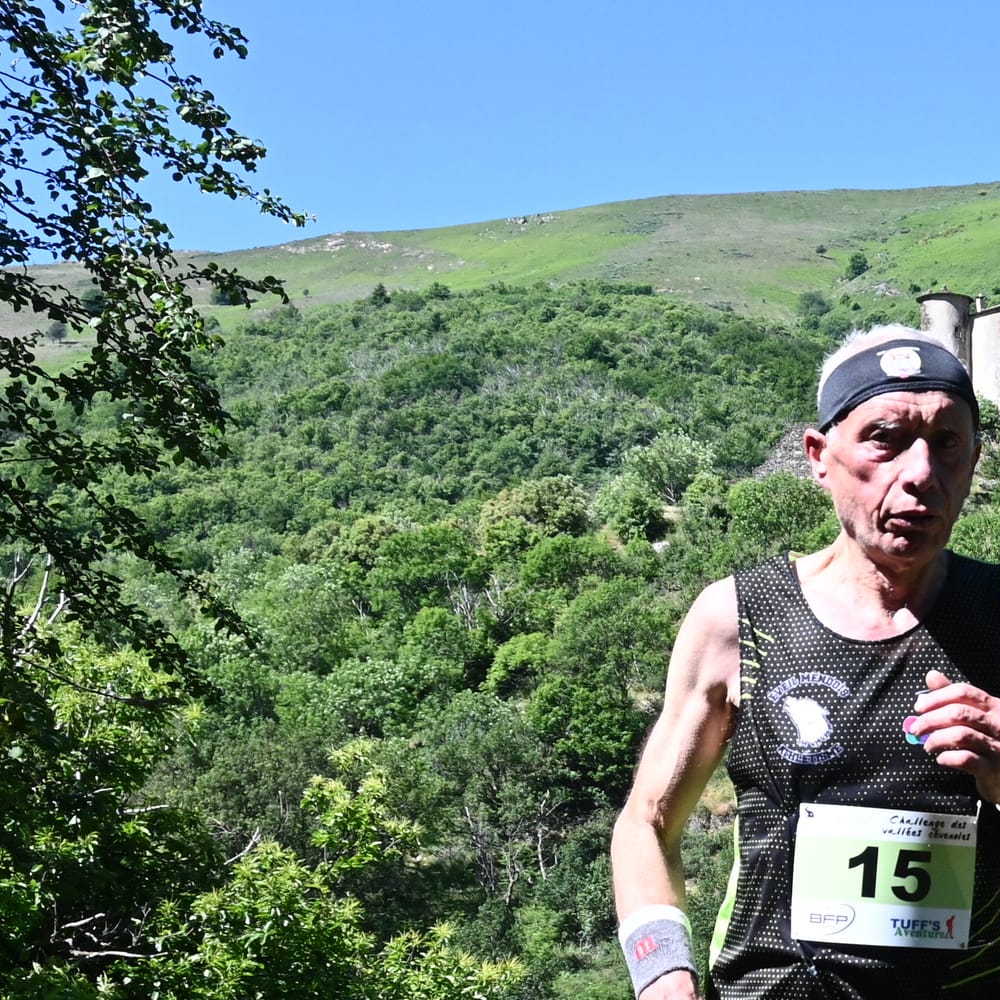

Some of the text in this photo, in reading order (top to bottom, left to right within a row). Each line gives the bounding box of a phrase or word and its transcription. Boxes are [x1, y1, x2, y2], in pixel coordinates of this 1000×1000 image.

[889, 815, 967, 830] Challenge des
[882, 827, 922, 837] vallées
[848, 846, 932, 902] 15
[809, 913, 848, 925] BFP
[890, 918, 941, 931] TUFF'S
[894, 927, 946, 940] Aventure
